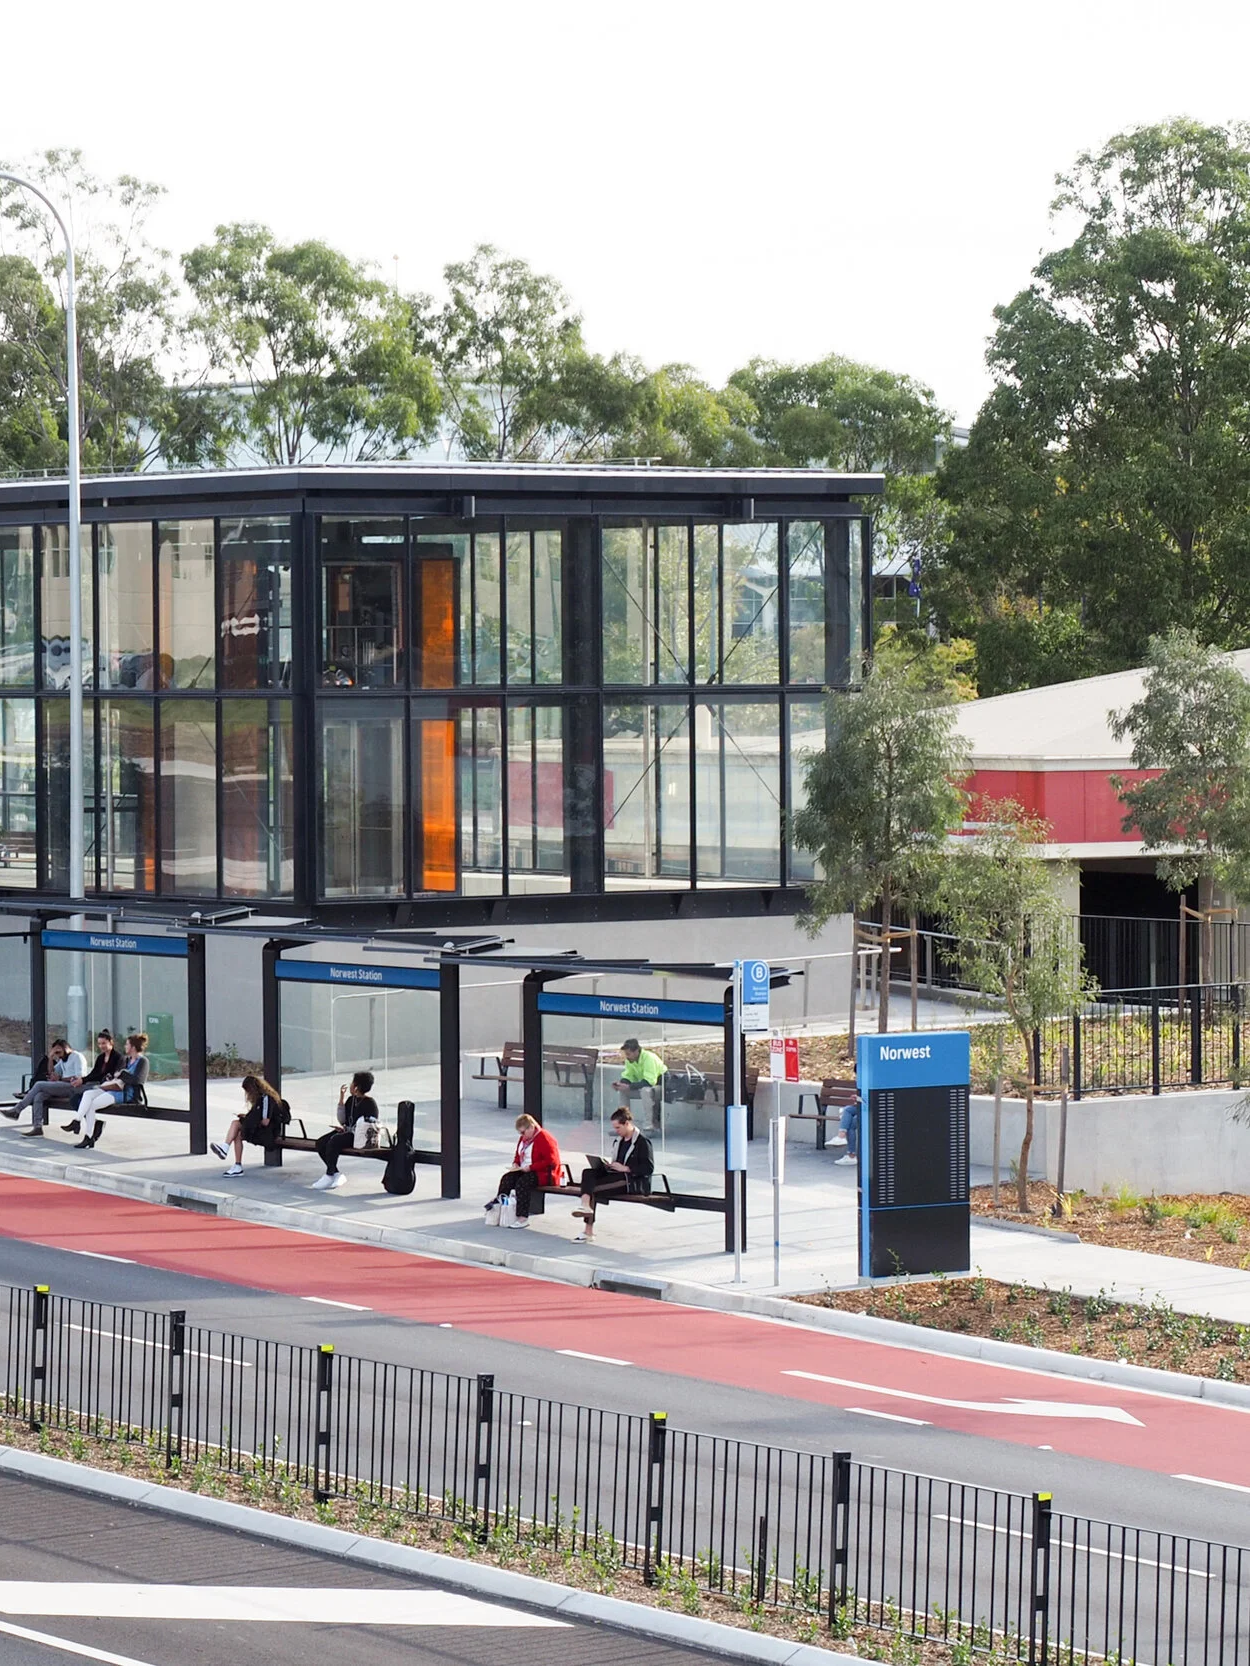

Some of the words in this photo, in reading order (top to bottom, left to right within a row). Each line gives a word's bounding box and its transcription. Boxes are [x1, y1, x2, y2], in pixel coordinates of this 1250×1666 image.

[90, 936, 115, 948] Norwest
[115, 937, 137, 949] Station
[330, 967, 357, 980] Norwest
[358, 968, 383, 981] Station
[755, 966, 763, 979] B
[599, 1000, 630, 1013] Norwest
[631, 1002, 659, 1015] Station
[880, 1045, 931, 1061] Norwest
